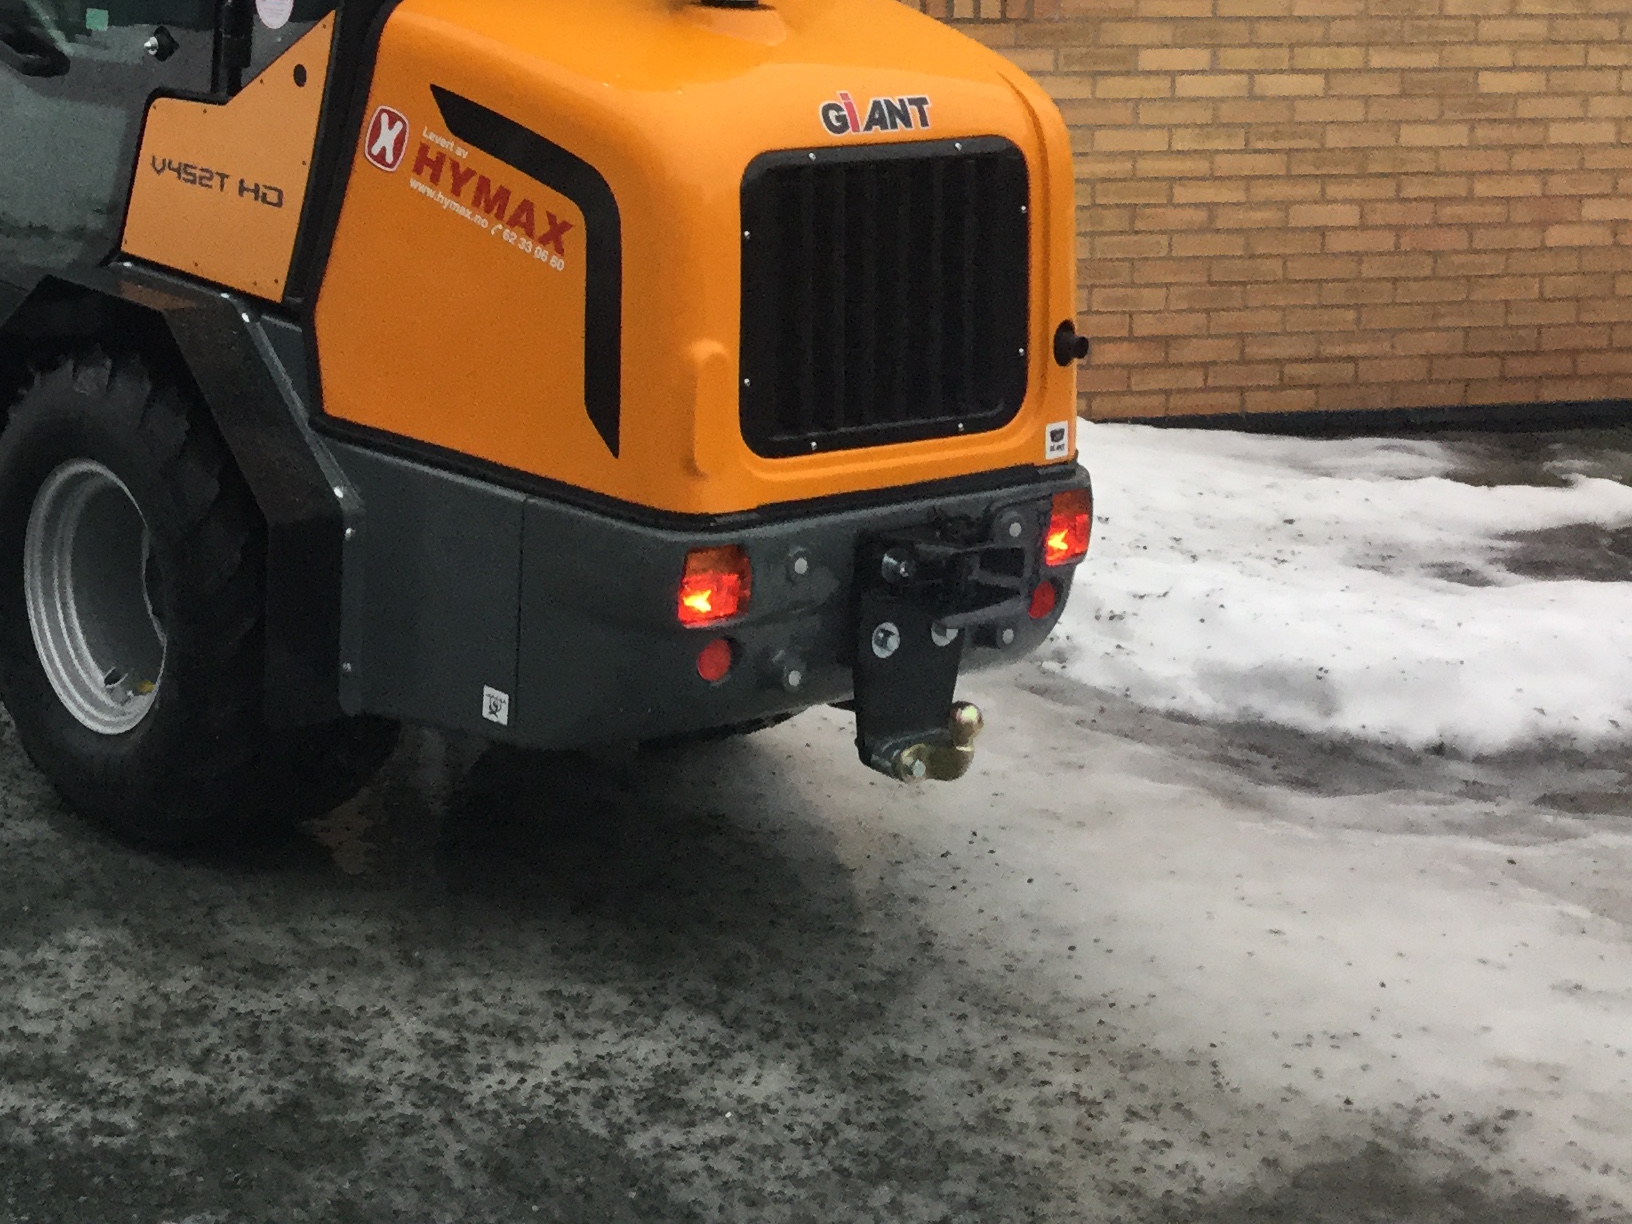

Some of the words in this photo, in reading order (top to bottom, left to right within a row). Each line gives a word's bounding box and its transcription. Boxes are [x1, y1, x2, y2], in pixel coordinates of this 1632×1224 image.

[422, 126, 454, 151] Levert
[454, 145, 468, 159] av
[151, 155, 230, 193] V452T
[237, 178, 284, 209] HD
[413, 142, 574, 257] HYMAX
[409, 178, 489, 229] www.hymax.no
[502, 228, 518, 246] 62
[518, 237, 533, 254] 33
